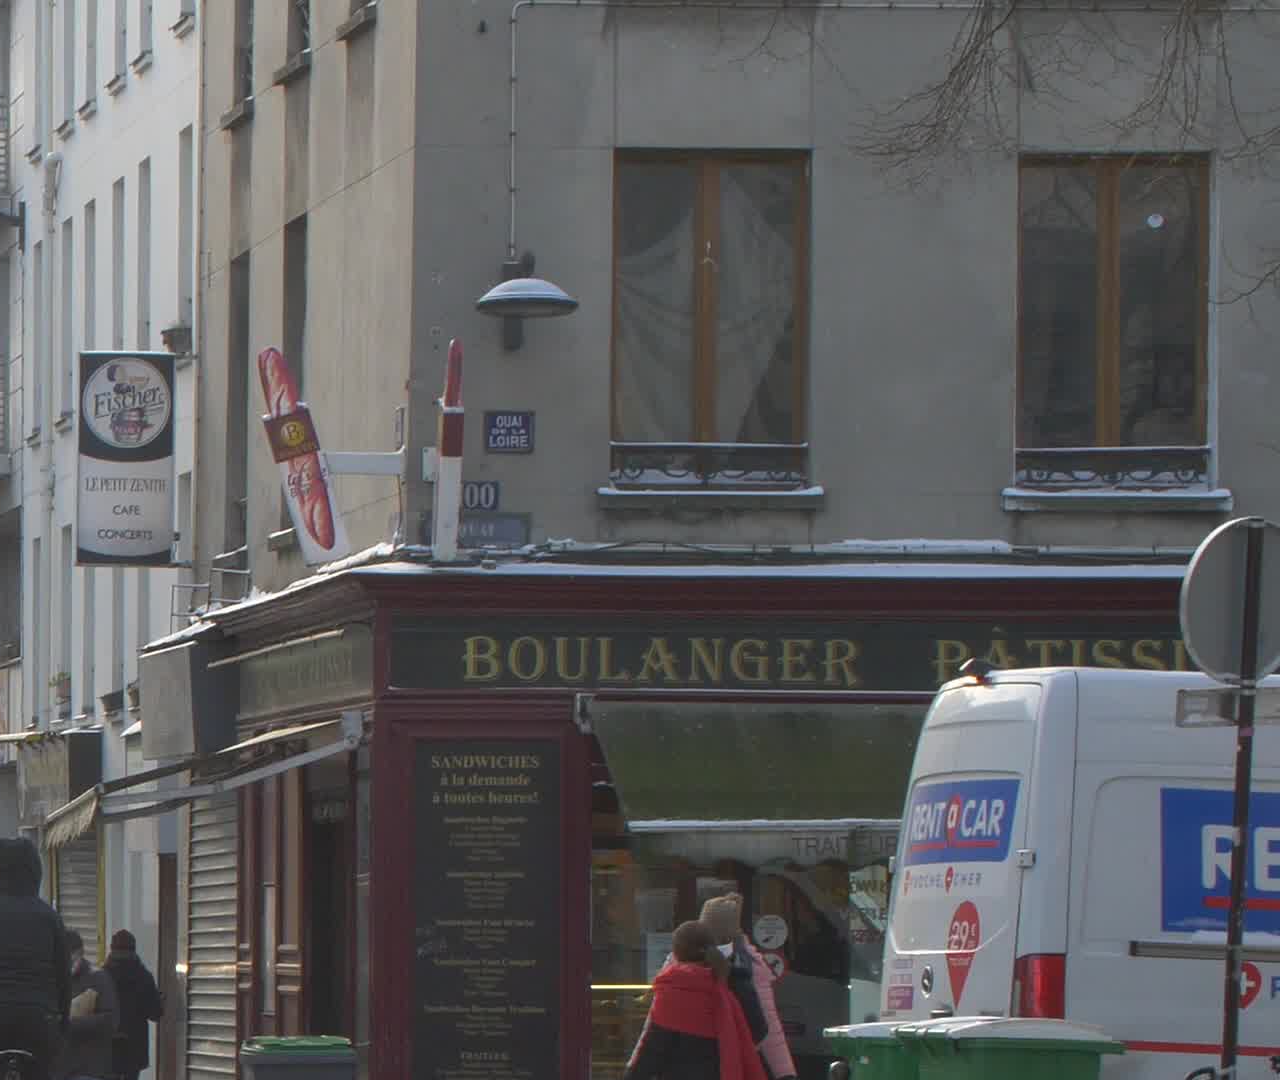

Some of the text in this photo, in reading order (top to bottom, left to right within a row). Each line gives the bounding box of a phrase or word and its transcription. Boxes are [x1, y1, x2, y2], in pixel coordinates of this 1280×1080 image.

[94, 386, 161, 418] Fischer
[495, 415, 523, 428] QUAI
[488, 435, 529, 448] LOIRE
[85, 477, 168, 493] LE PETIT ZENITH
[112, 504, 142, 516] CAFE
[97, 528, 153, 541] CONCERTS
[461, 635, 860, 688] BOULANGER
[431, 755, 541, 769] SANDWICHES
[468, 772, 532, 786] demande
[444, 791, 482, 804] toutes
[911, 801, 947, 841] RENT
[960, 798, 1005, 838] CAR
